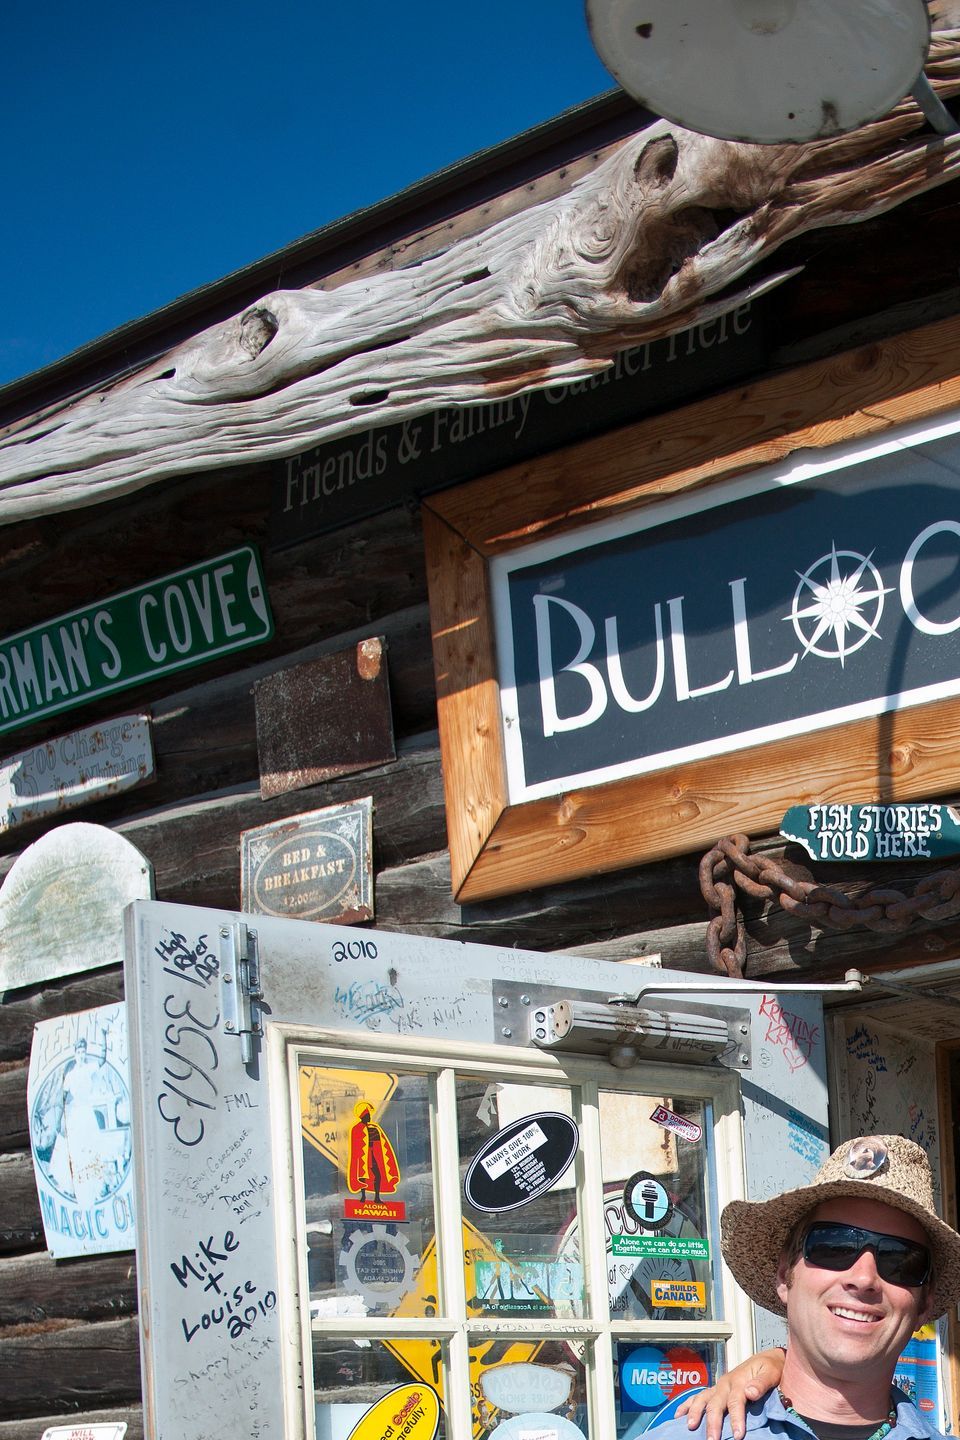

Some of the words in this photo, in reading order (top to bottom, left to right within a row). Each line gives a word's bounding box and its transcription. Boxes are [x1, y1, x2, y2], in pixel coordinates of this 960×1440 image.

[283, 429, 387, 512] Friends
[397, 420, 422, 464] &
[139, 564, 246, 662] COVE
[808, 806, 852, 831] FISH
[858, 805, 943, 832] STORIES
[283, 849, 311, 867] BED
[316, 844, 327, 857] &
[817, 831, 869, 859] TOLD
[875, 832, 931, 857] HERE
[264, 859, 345, 890] BREAKFAST
[333, 940, 378, 962] 2010
[224, 1093, 259, 1112] FML
[669, 1114, 699, 1134] DOMINION
[485, 1148, 509, 1169] ALWAYS
[509, 1138, 523, 1154] GIVE
[522, 1127, 539, 1141] 100%
[504, 1159, 513, 1167] AT
[513, 1144, 531, 1160] WORK
[40, 1189, 110, 1241] MAGIC
[614, 1243, 645, 1253] Together
[688, 1241, 704, 1249] little
[670, 1285, 698, 1293] BUILDS
[182, 1280, 256, 1342] Louise
[227, 1291, 276, 1339] 2010
[631, 1368, 701, 1385] Maestro
[71, 1429, 94, 1437] WILL
